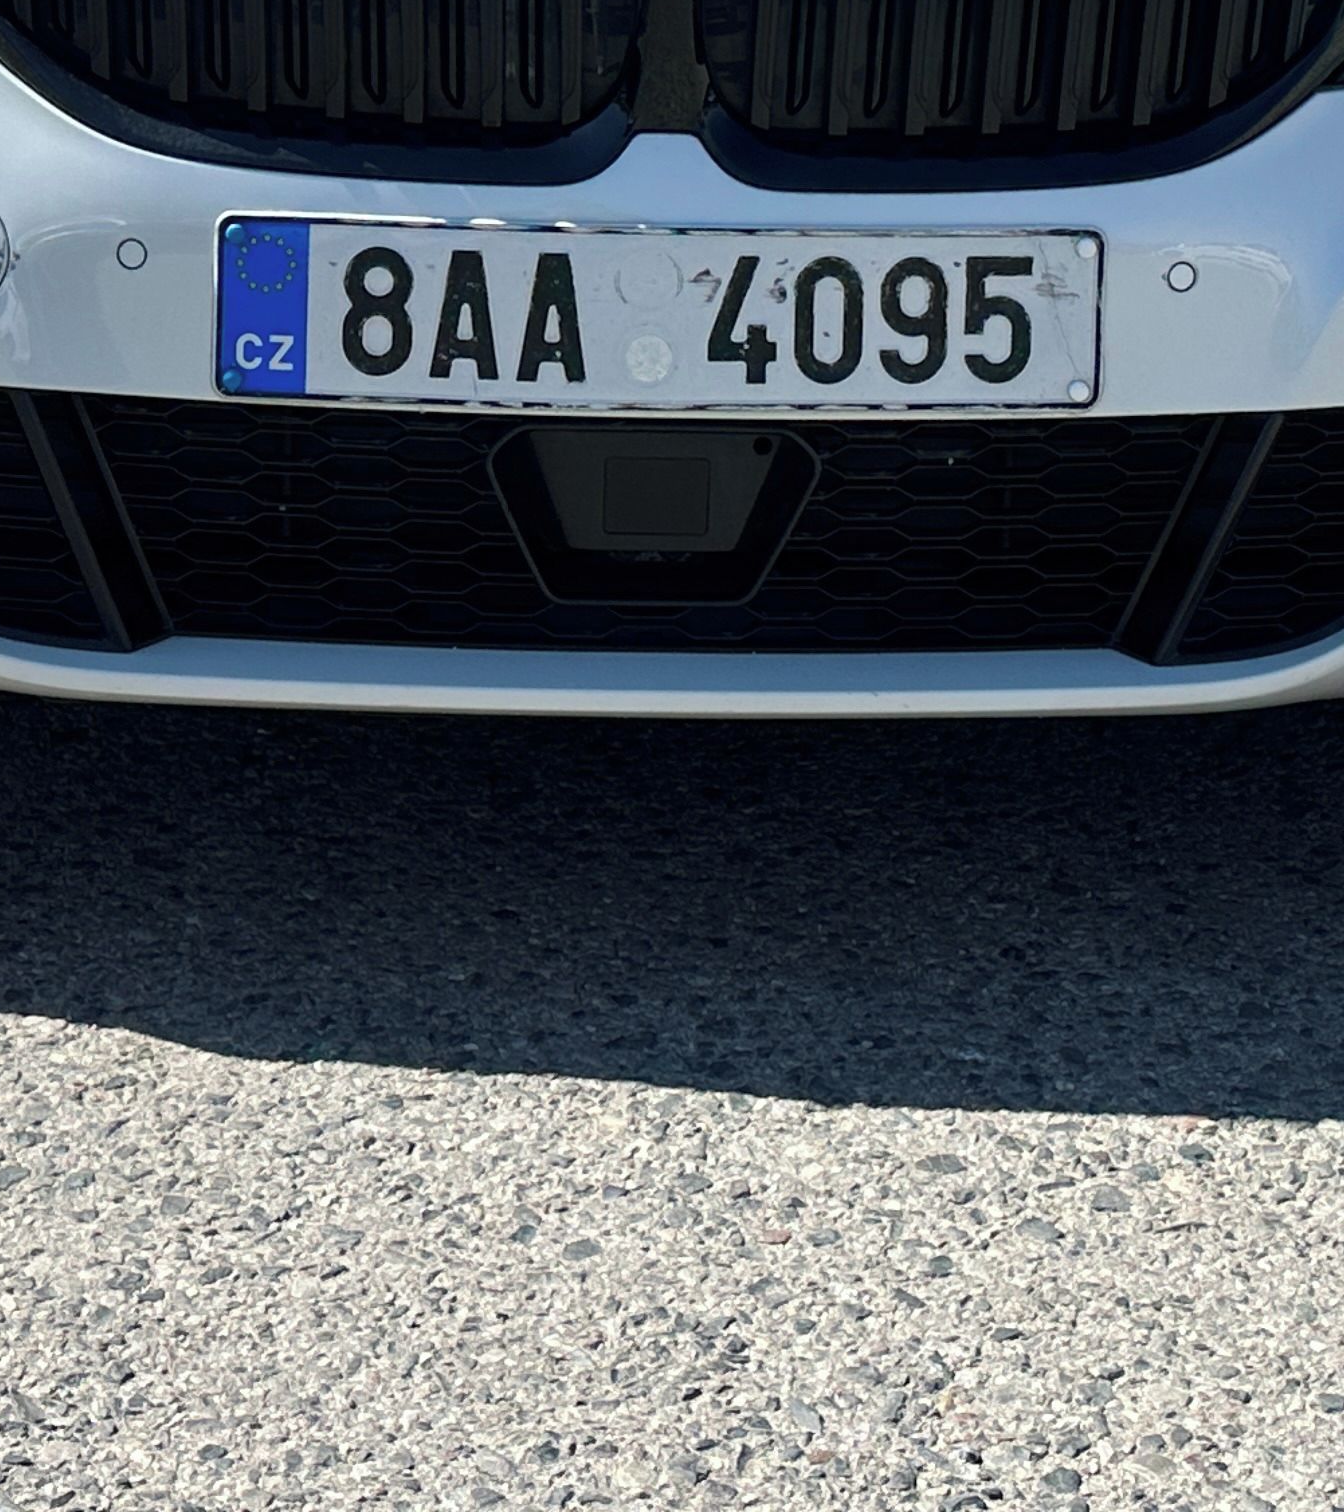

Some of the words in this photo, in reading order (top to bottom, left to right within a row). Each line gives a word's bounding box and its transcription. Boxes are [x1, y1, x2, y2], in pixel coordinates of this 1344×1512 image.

[235, 332, 295, 371] CZ
[341, 246, 587, 383] 8AA
[707, 255, 1034, 384] 4095
